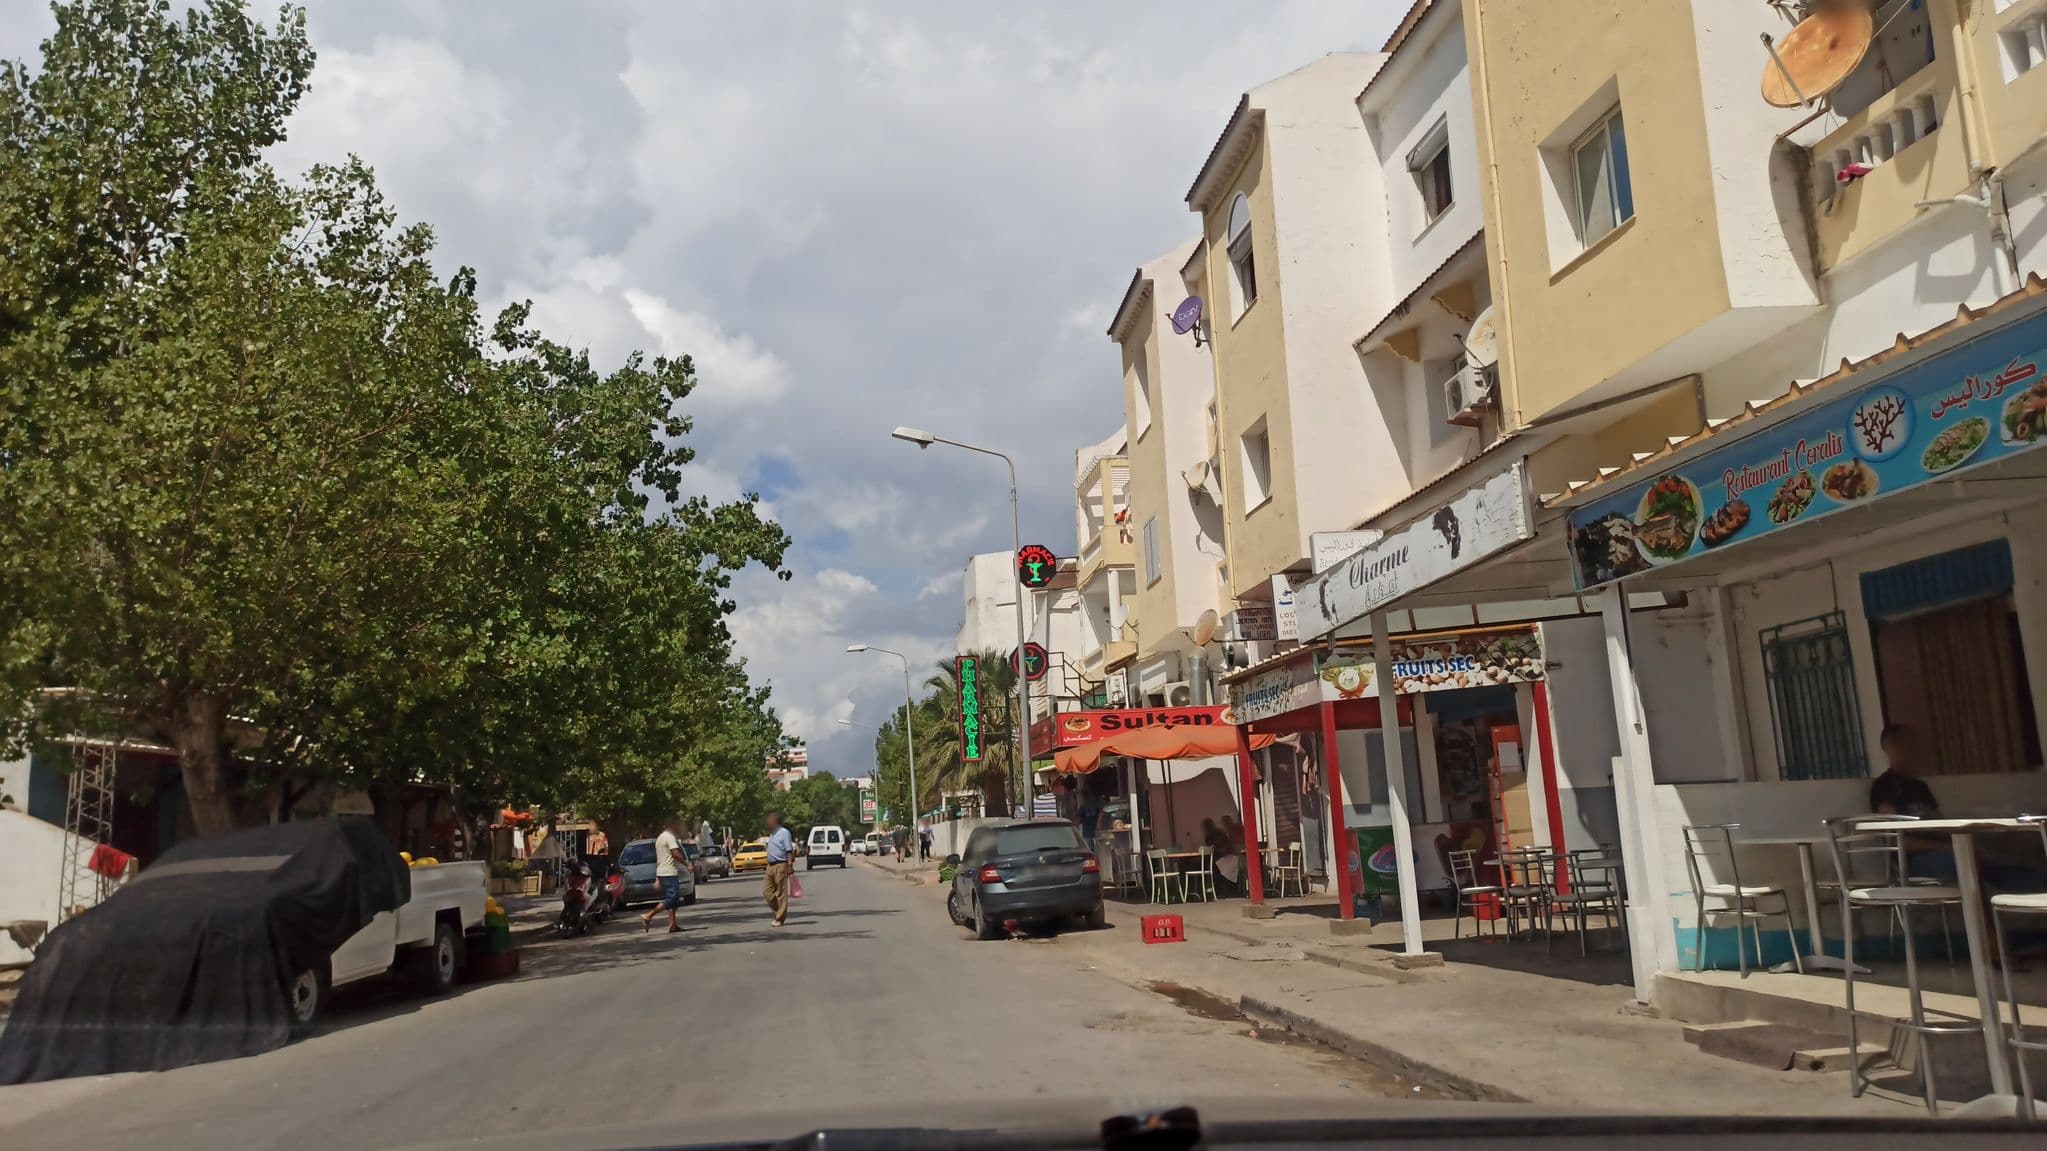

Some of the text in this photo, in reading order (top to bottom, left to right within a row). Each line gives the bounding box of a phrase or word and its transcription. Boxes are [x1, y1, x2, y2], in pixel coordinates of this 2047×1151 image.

[1931, 355, 2037, 419] كوراليس
[1723, 431, 1844, 500] Restaurant Coralis
[1349, 545, 1409, 590] Charme
[1449, 655, 1475, 672] SEC
[962, 660, 979, 759] PHARMACIE
[1100, 712, 1213, 732] Sultan
